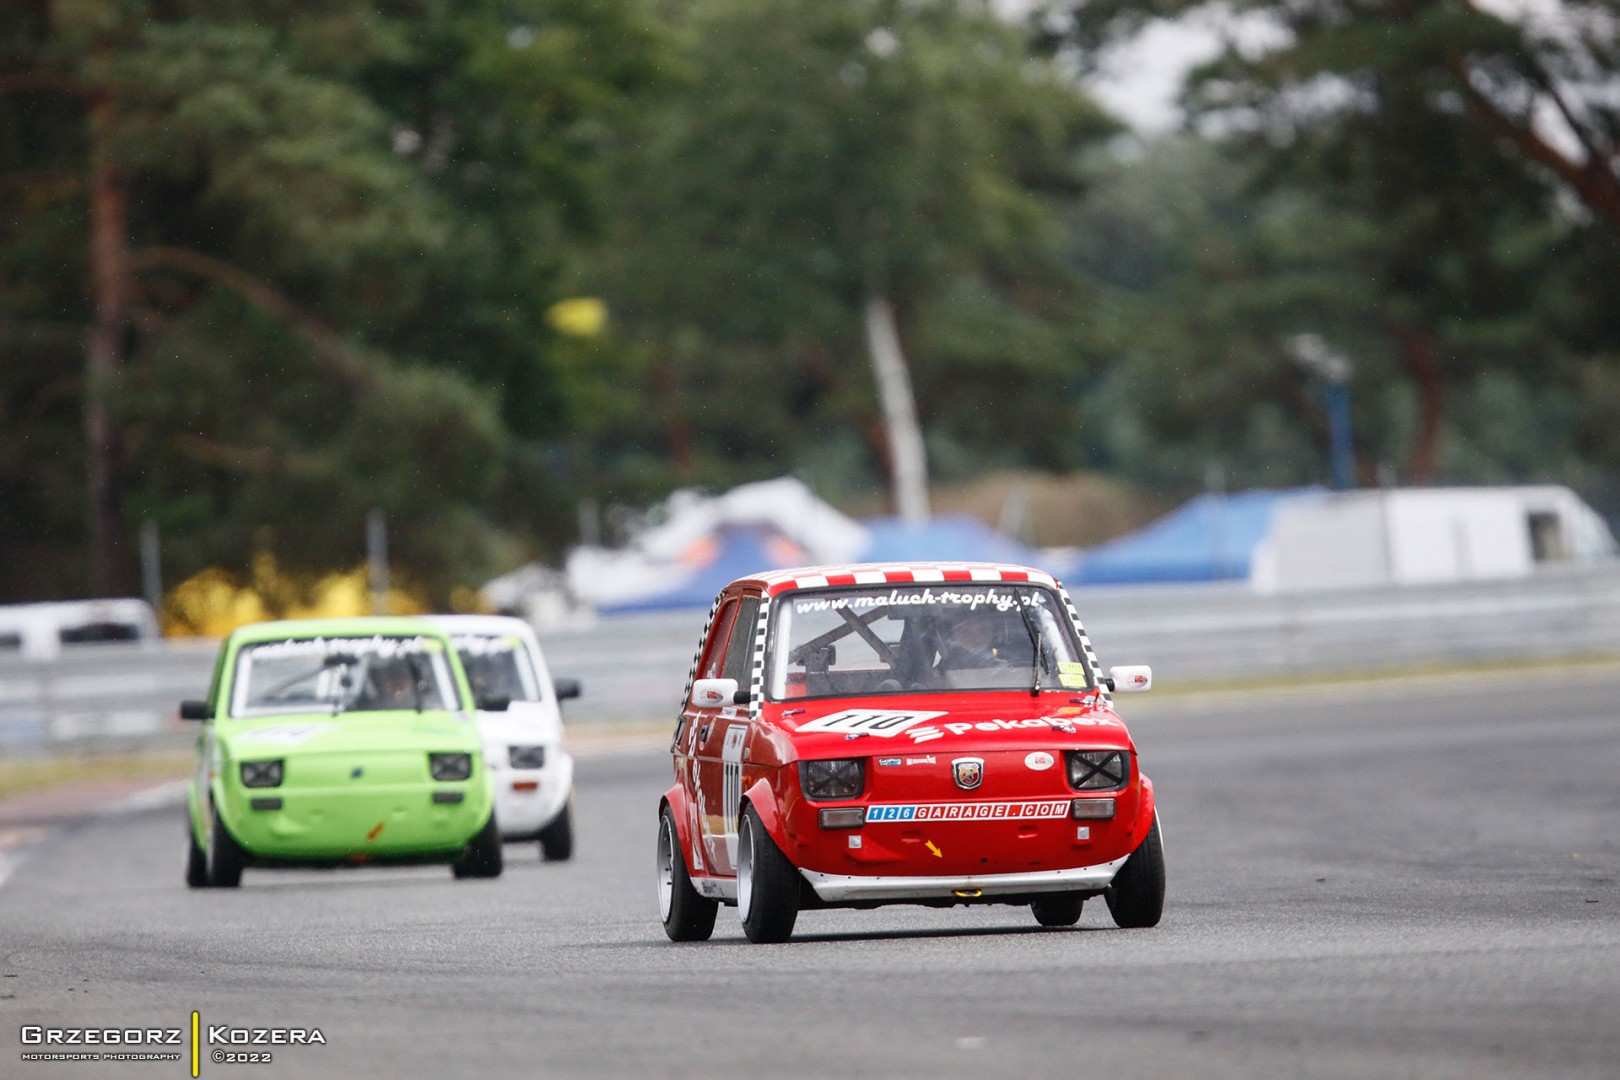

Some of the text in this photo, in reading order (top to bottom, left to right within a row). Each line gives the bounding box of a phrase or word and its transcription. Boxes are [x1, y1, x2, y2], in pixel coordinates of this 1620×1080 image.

[797, 588, 1040, 614] www.maluch-trophy.pl
[823, 714, 914, 730] 110
[943, 716, 1121, 735] Pekabex
[871, 803, 1066, 820] 126GARAGE.COM
